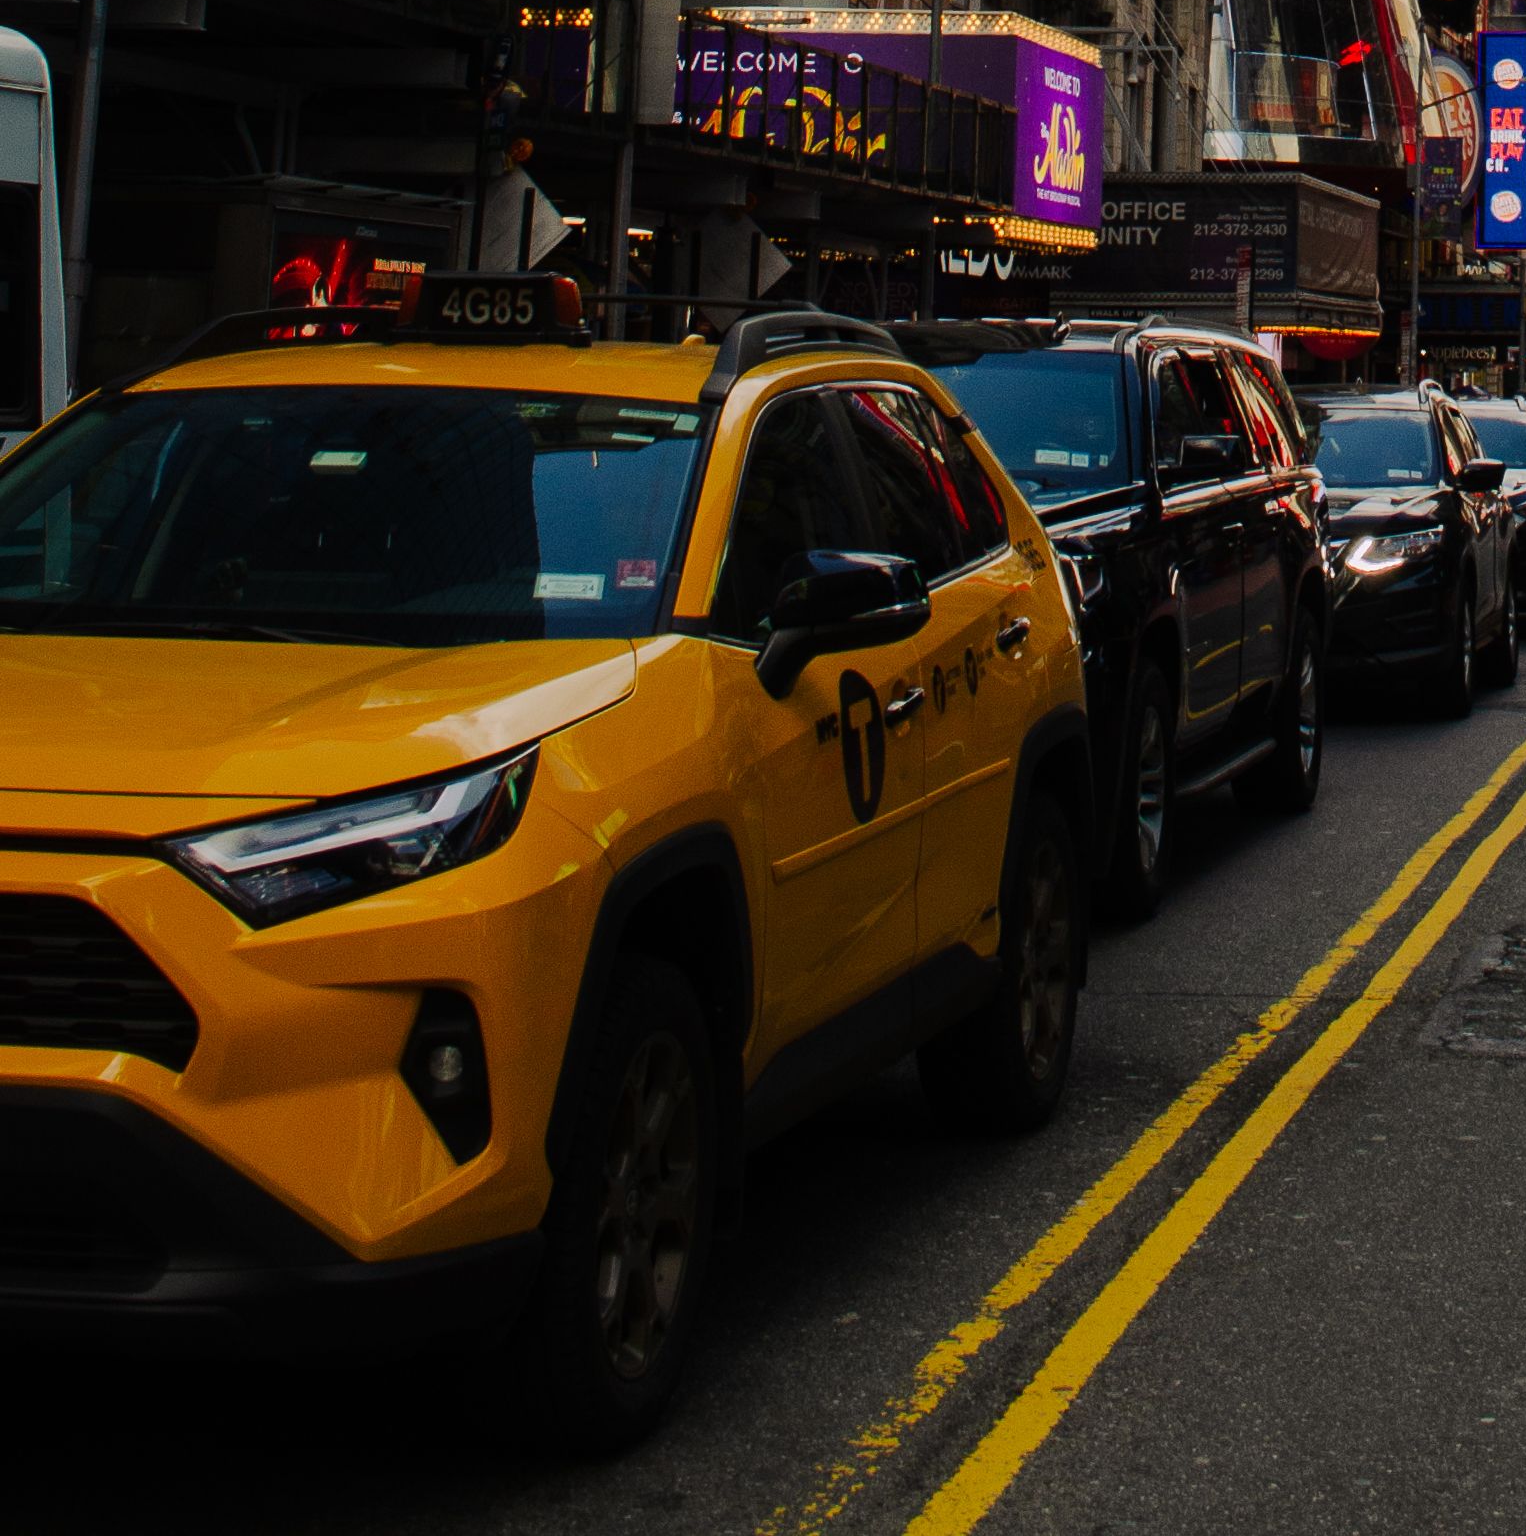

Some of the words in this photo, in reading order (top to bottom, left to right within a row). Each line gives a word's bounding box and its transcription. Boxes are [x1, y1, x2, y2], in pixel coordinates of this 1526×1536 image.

[1044, 66, 1072, 95] WELCOME
[1072, 76, 1081, 98] TO
[1100, 201, 1187, 222] OFFICE
[1193, 223, 1288, 237] 212-372-2430
[441, 288, 535, 326] 4G85
